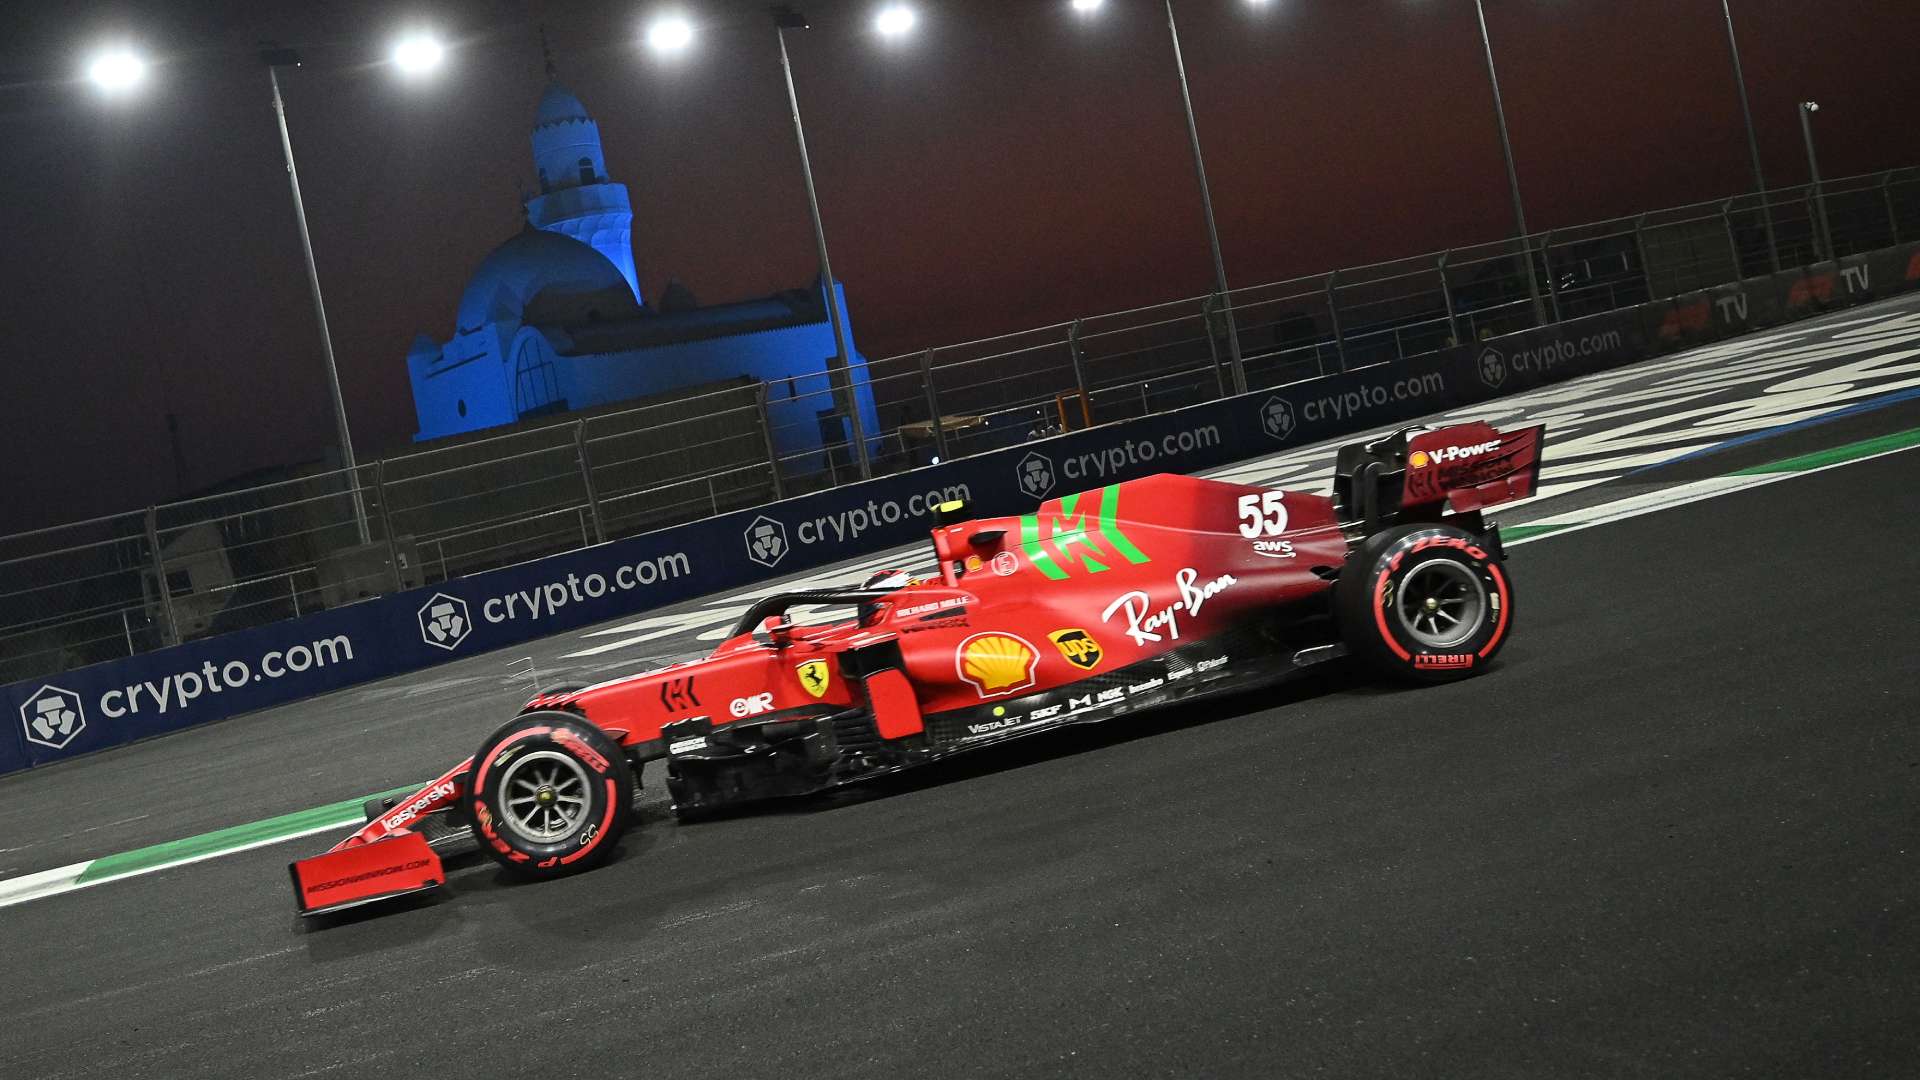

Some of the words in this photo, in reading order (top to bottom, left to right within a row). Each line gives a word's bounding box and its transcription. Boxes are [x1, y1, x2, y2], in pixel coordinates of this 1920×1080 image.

[1840, 264, 1869, 293] TV
[1716, 293, 1748, 323] TV
[1511, 330, 1621, 371] crypto.com
[1303, 372, 1445, 421] crypto.com
[1063, 425, 1221, 479] crypto.com
[797, 483, 971, 544] crypto.com
[1238, 490, 1288, 538] 55
[1252, 541, 1294, 554] aws
[483, 552, 691, 623] crypto.com
[1102, 567, 1237, 647] Ray-Ban
[1059, 638, 1098, 662] ups
[100, 635, 353, 718] crypto.com
[382, 780, 455, 831] kaspersky
